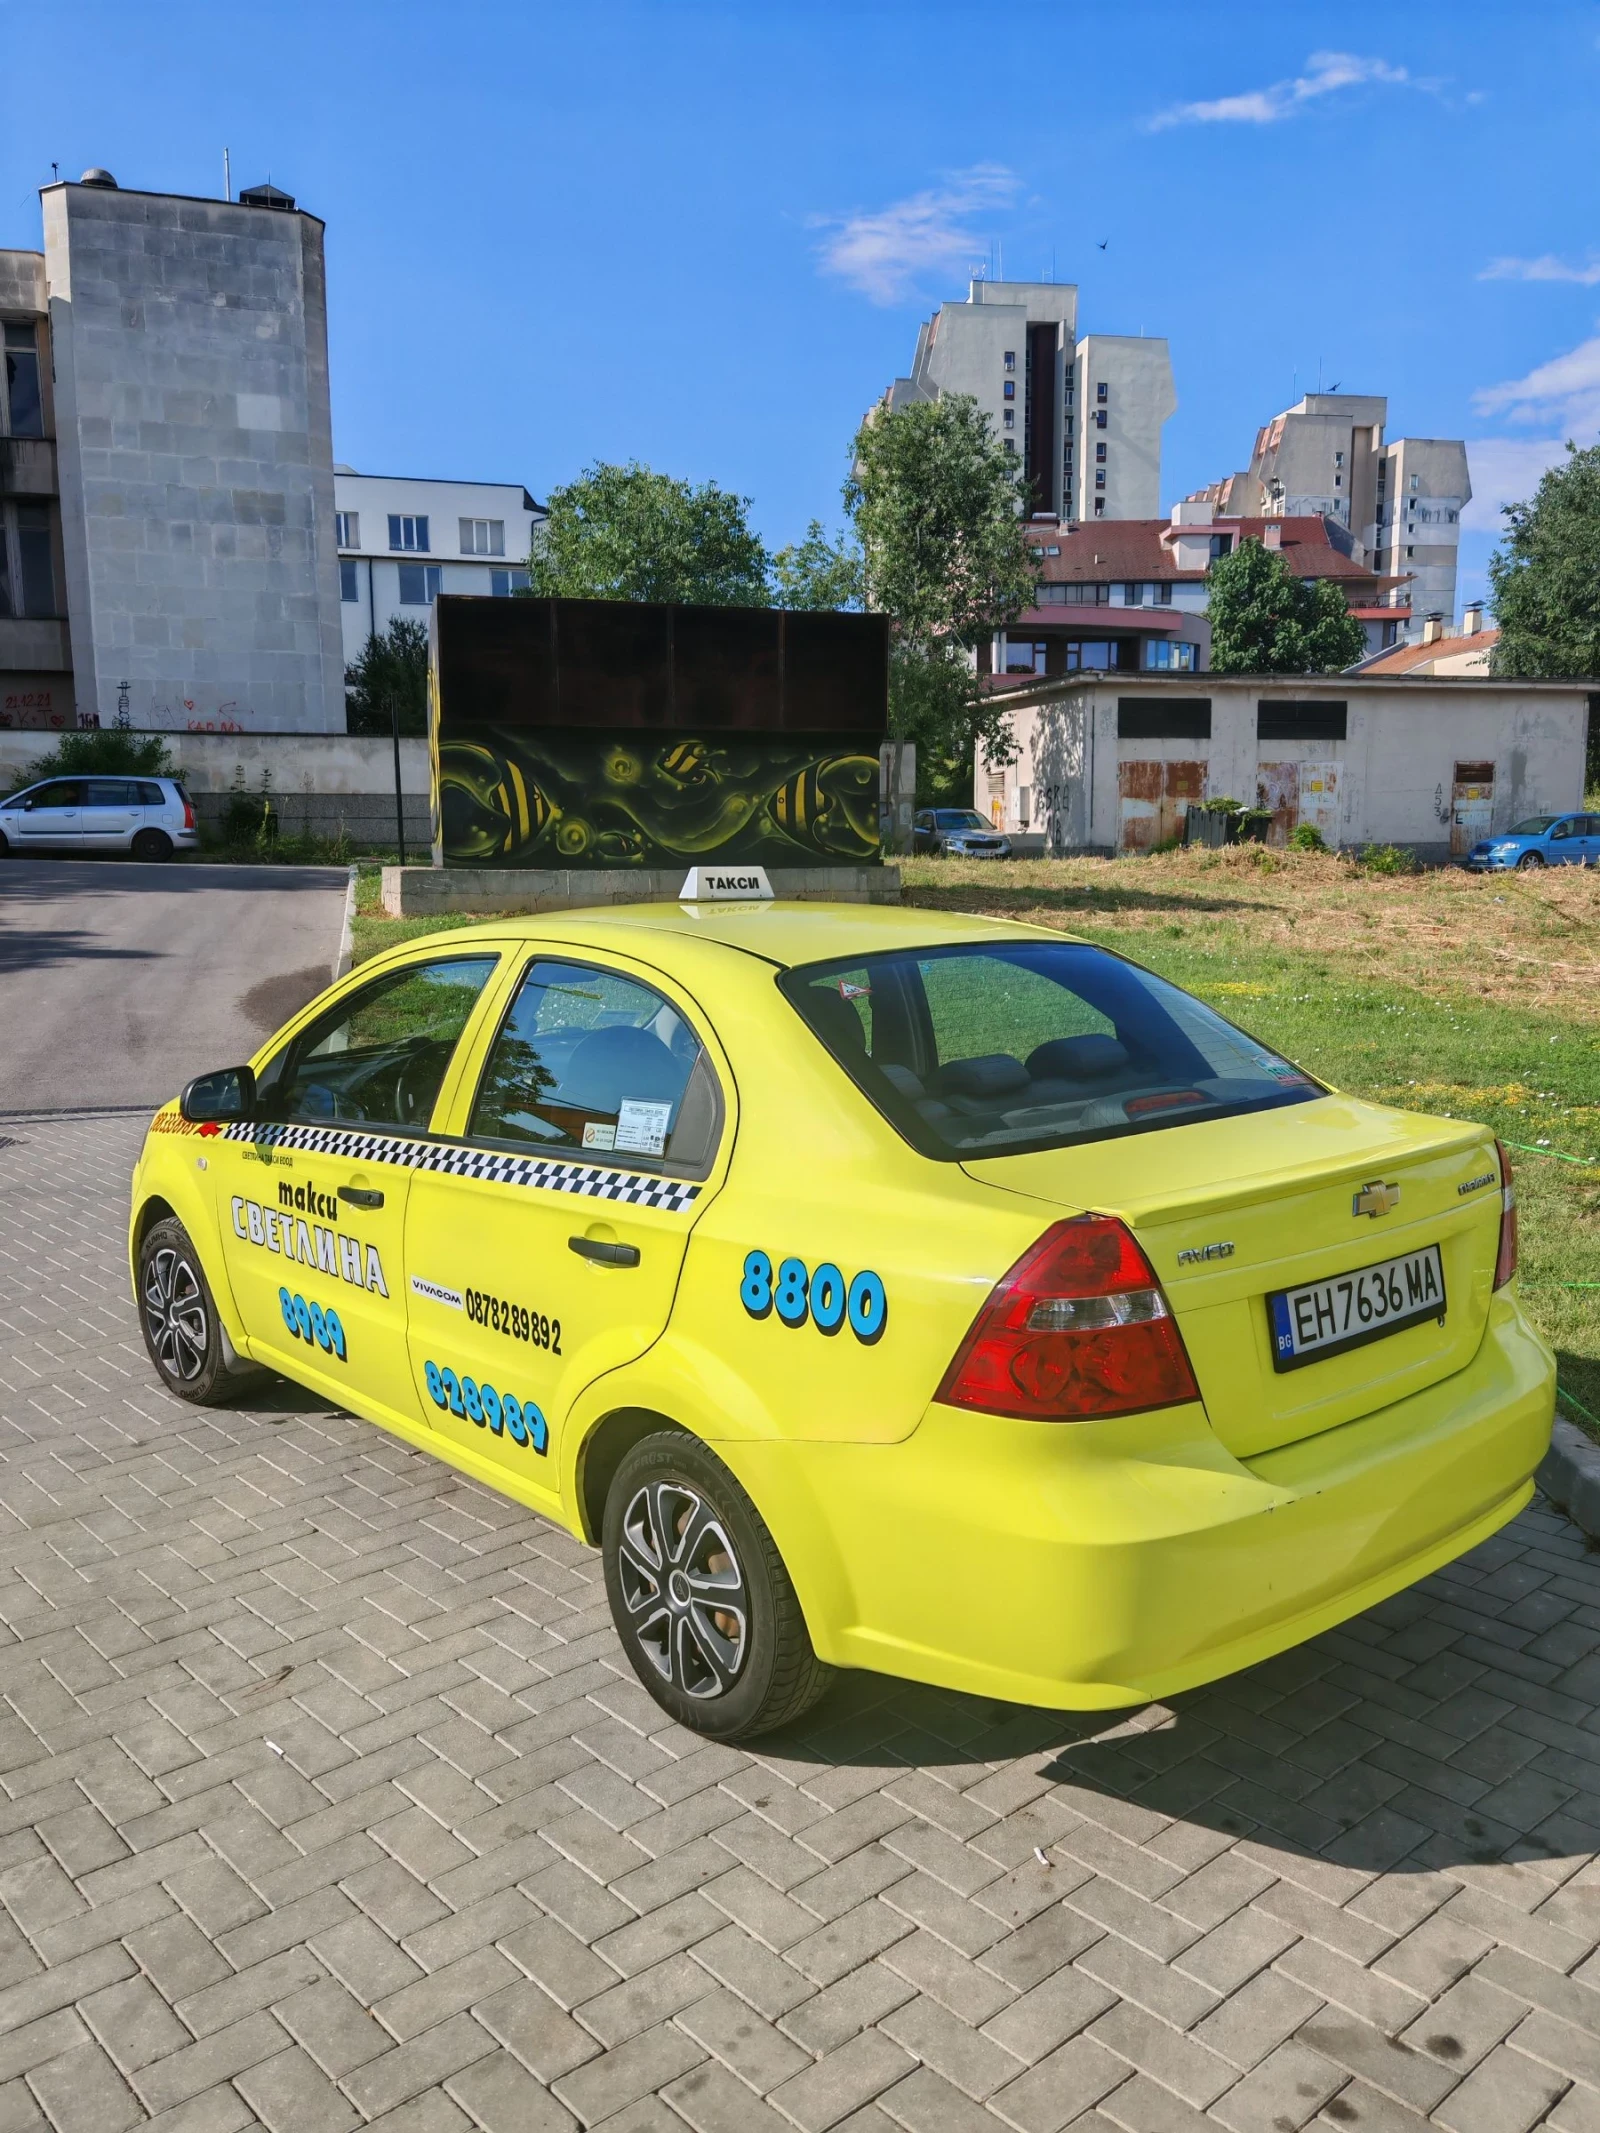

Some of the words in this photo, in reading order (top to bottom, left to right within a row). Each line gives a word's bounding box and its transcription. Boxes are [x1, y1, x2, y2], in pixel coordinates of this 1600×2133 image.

[705, 877, 760, 889] ТАКСИ
[231, 1195, 390, 1299] СВЕТЛИНА
[278, 1287, 348, 1363] 8989
[412, 1280, 462, 1305] VIVACOM
[465, 1287, 562, 1356] 0878289892
[740, 1249, 888, 1346] 8800
[1278, 1333, 1292, 1351] BG
[424, 1360, 548, 1458] 828989
